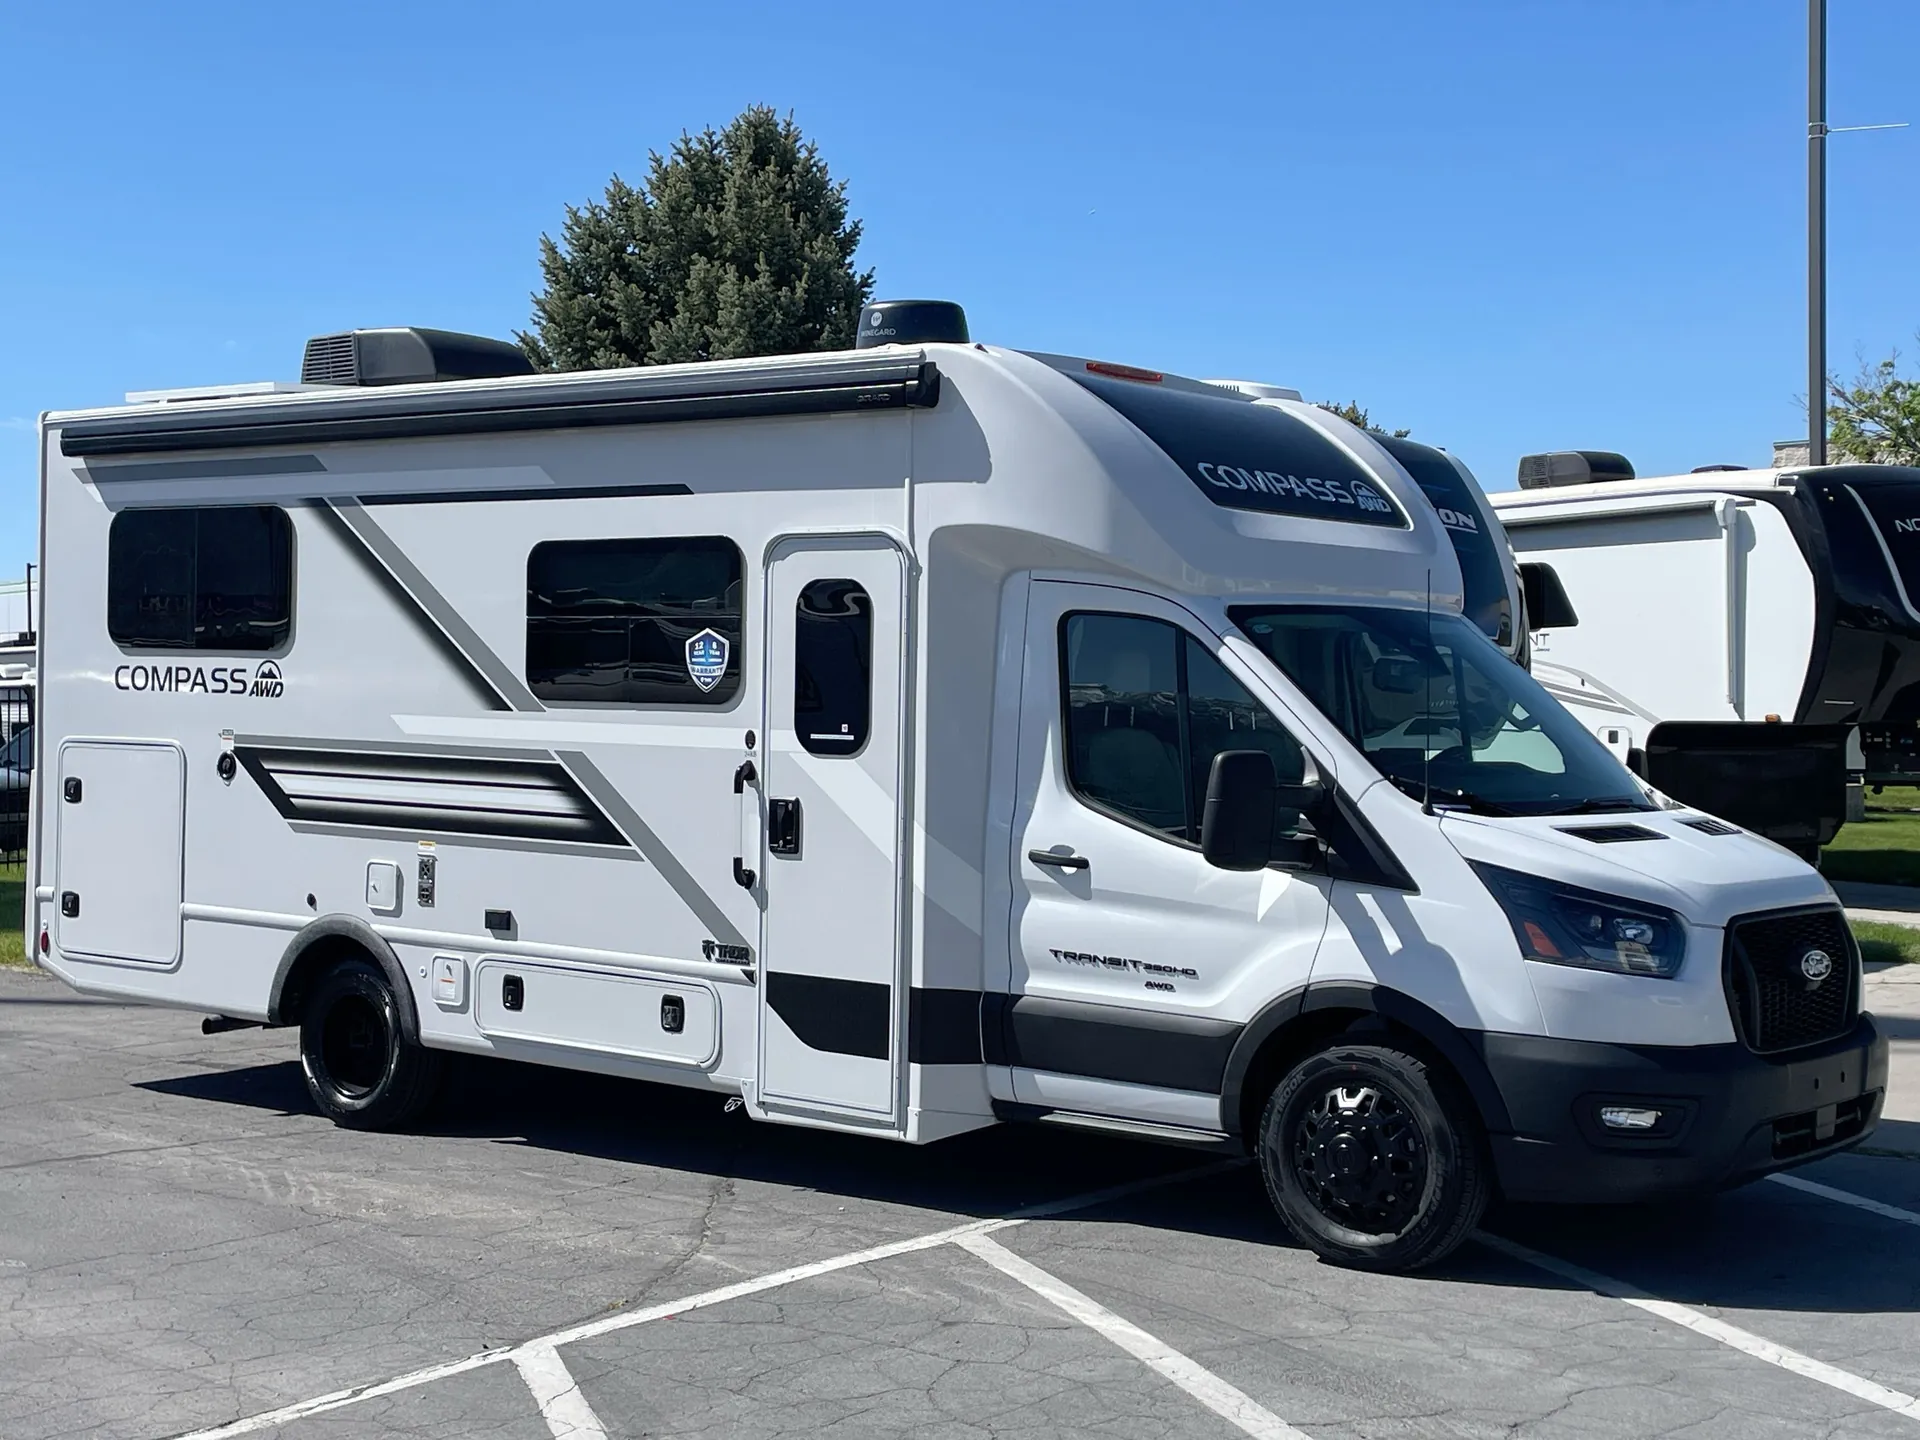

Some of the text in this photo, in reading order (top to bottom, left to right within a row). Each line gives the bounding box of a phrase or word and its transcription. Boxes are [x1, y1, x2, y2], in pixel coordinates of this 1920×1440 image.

[861, 328, 896, 337] WINEGARD
[1197, 461, 1392, 513] COMPASS AWD
[114, 664, 285, 699] COMPASS AWD
[715, 944, 750, 961] THOR
[1048, 949, 1142, 971] TRANSIT
[1144, 980, 1175, 992] AWD
